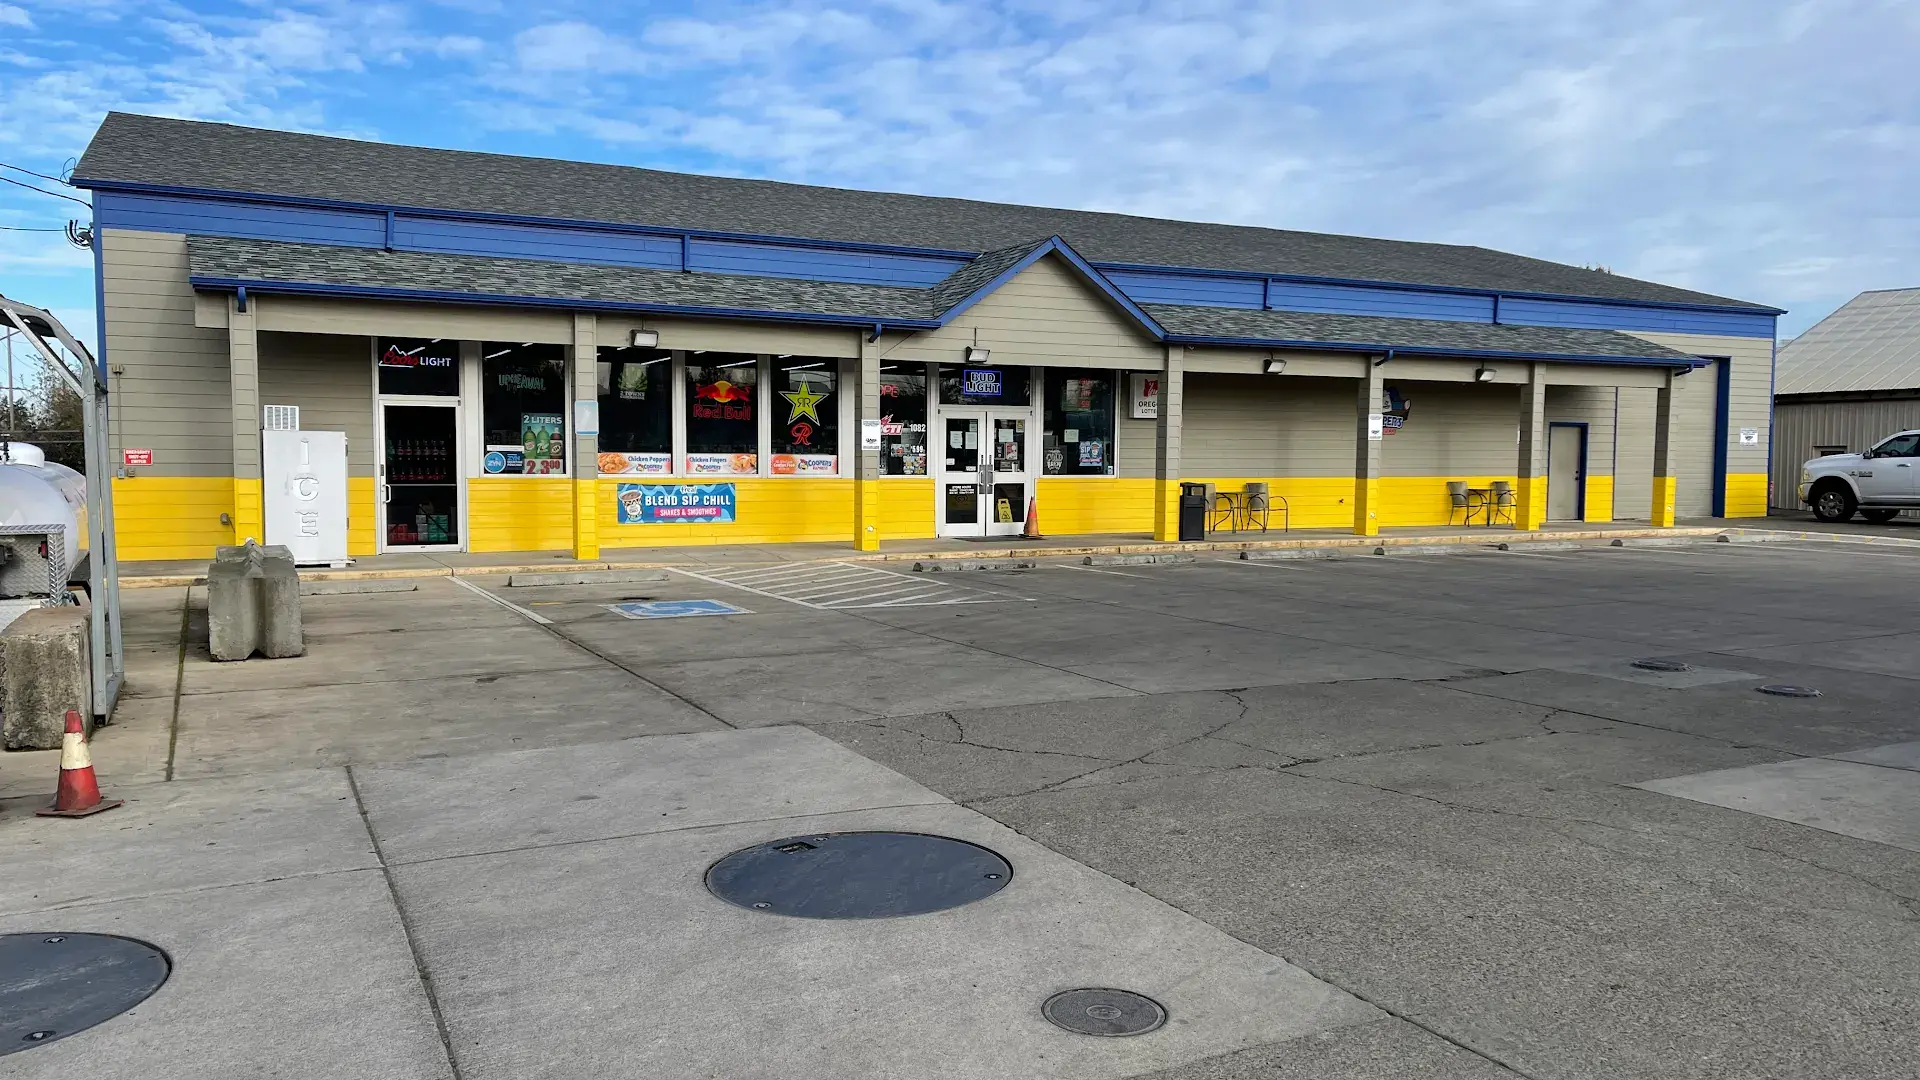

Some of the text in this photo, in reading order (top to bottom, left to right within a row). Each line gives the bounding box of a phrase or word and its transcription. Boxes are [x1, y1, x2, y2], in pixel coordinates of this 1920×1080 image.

[383, 350, 452, 367] Coors LIGHT
[970, 371, 996, 383] BUD
[965, 381, 1001, 393] LIGHT
[693, 403, 751, 420] Red Bull
[523, 415, 563, 424] 2 LITERS
[791, 422, 813, 446] R
[910, 423, 926, 433] 1082
[293, 437, 320, 538] ICE
[644, 495, 731, 506] BLEND SIP CHILL
[660, 507, 717, 517] SHAKES & SMOOTHIES
